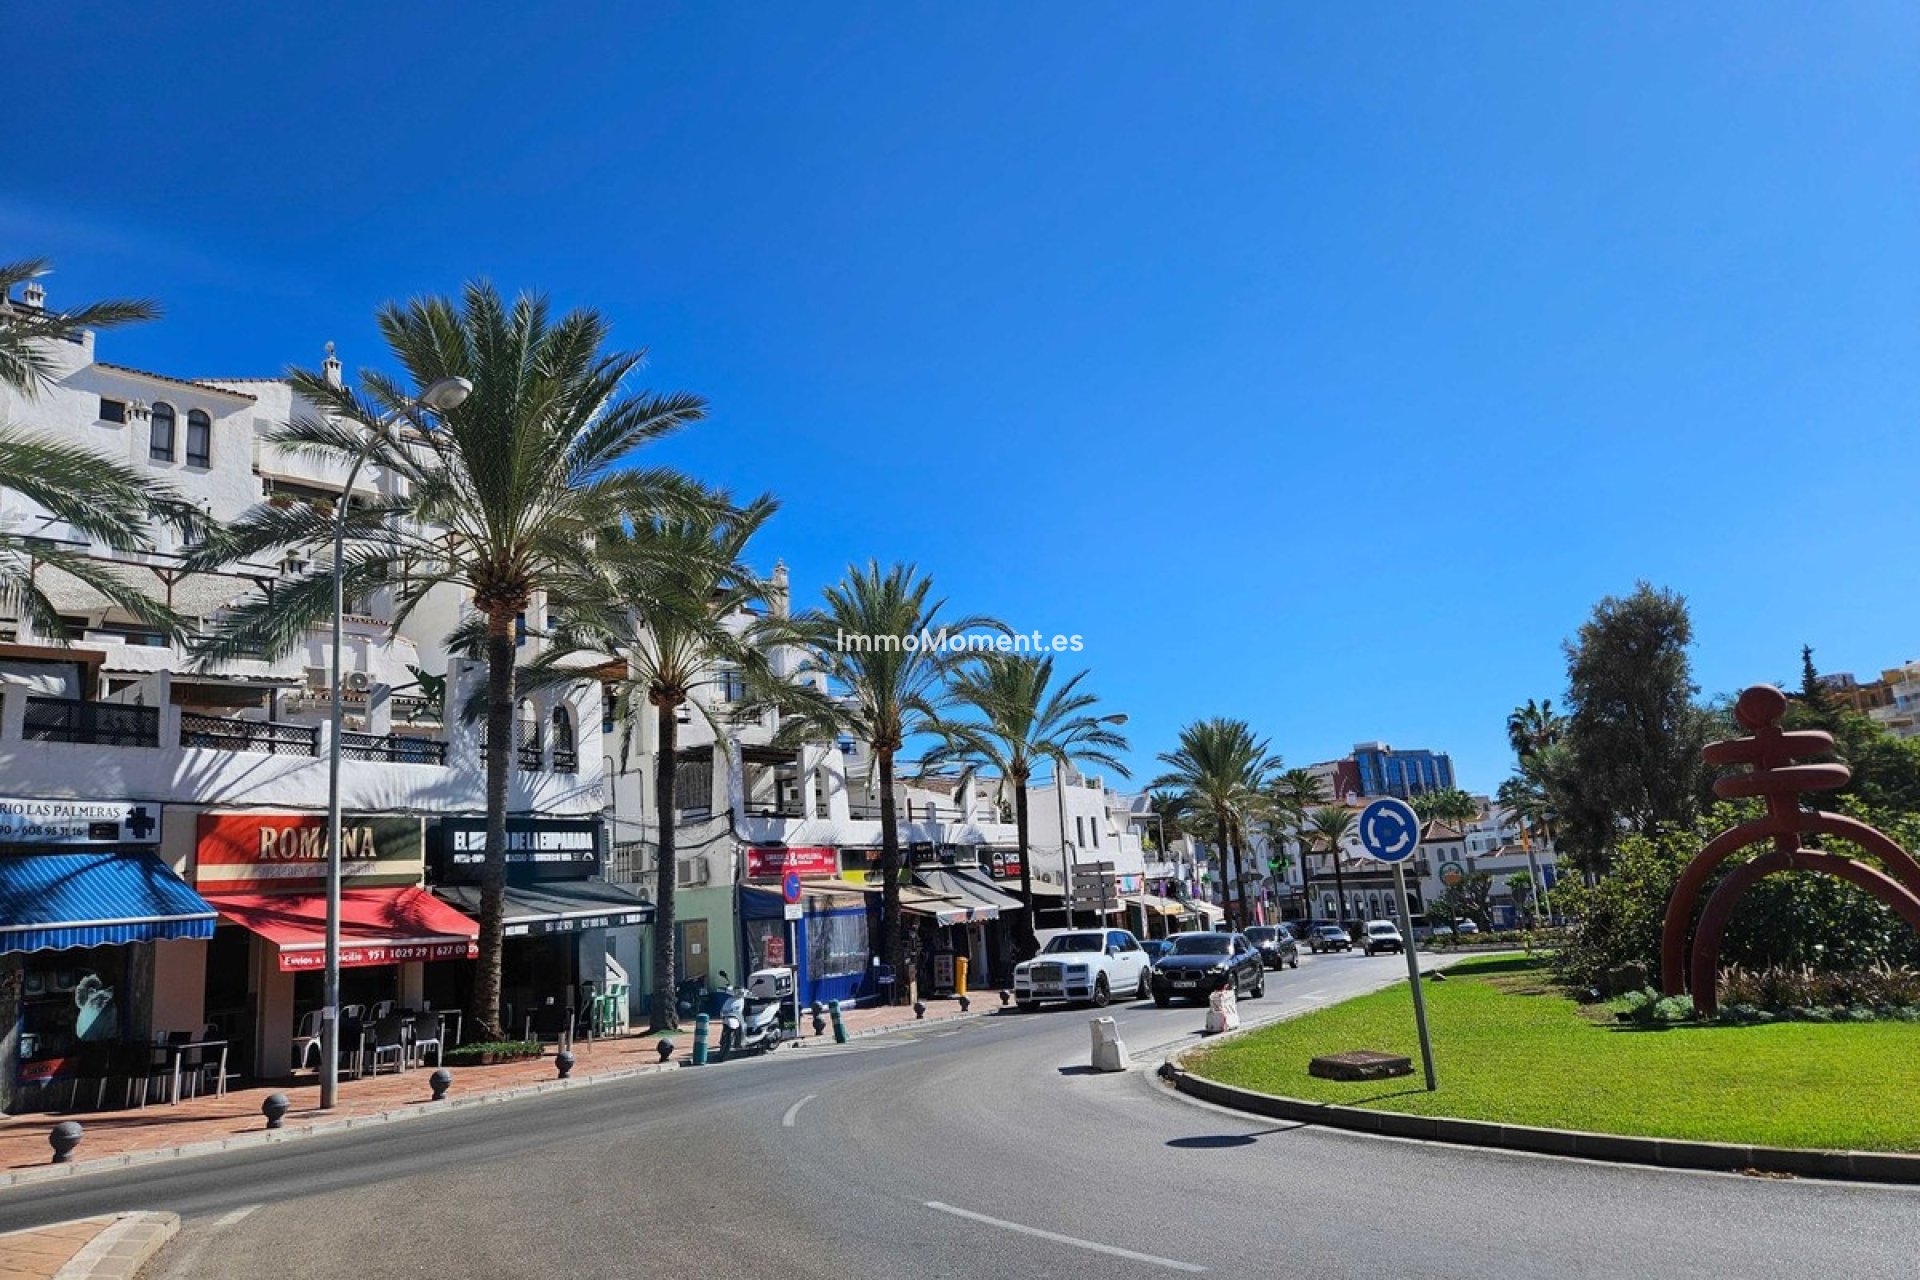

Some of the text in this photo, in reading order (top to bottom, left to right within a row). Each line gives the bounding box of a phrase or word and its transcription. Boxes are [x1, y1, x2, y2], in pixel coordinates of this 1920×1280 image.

[26, 804, 51, 816] LAS
[54, 805, 121, 818] PALMERAS
[367, 949, 385, 961] 951
[390, 947, 414, 959] 1029
[415, 946, 428, 958] 29
[436, 945, 453, 956] 627
